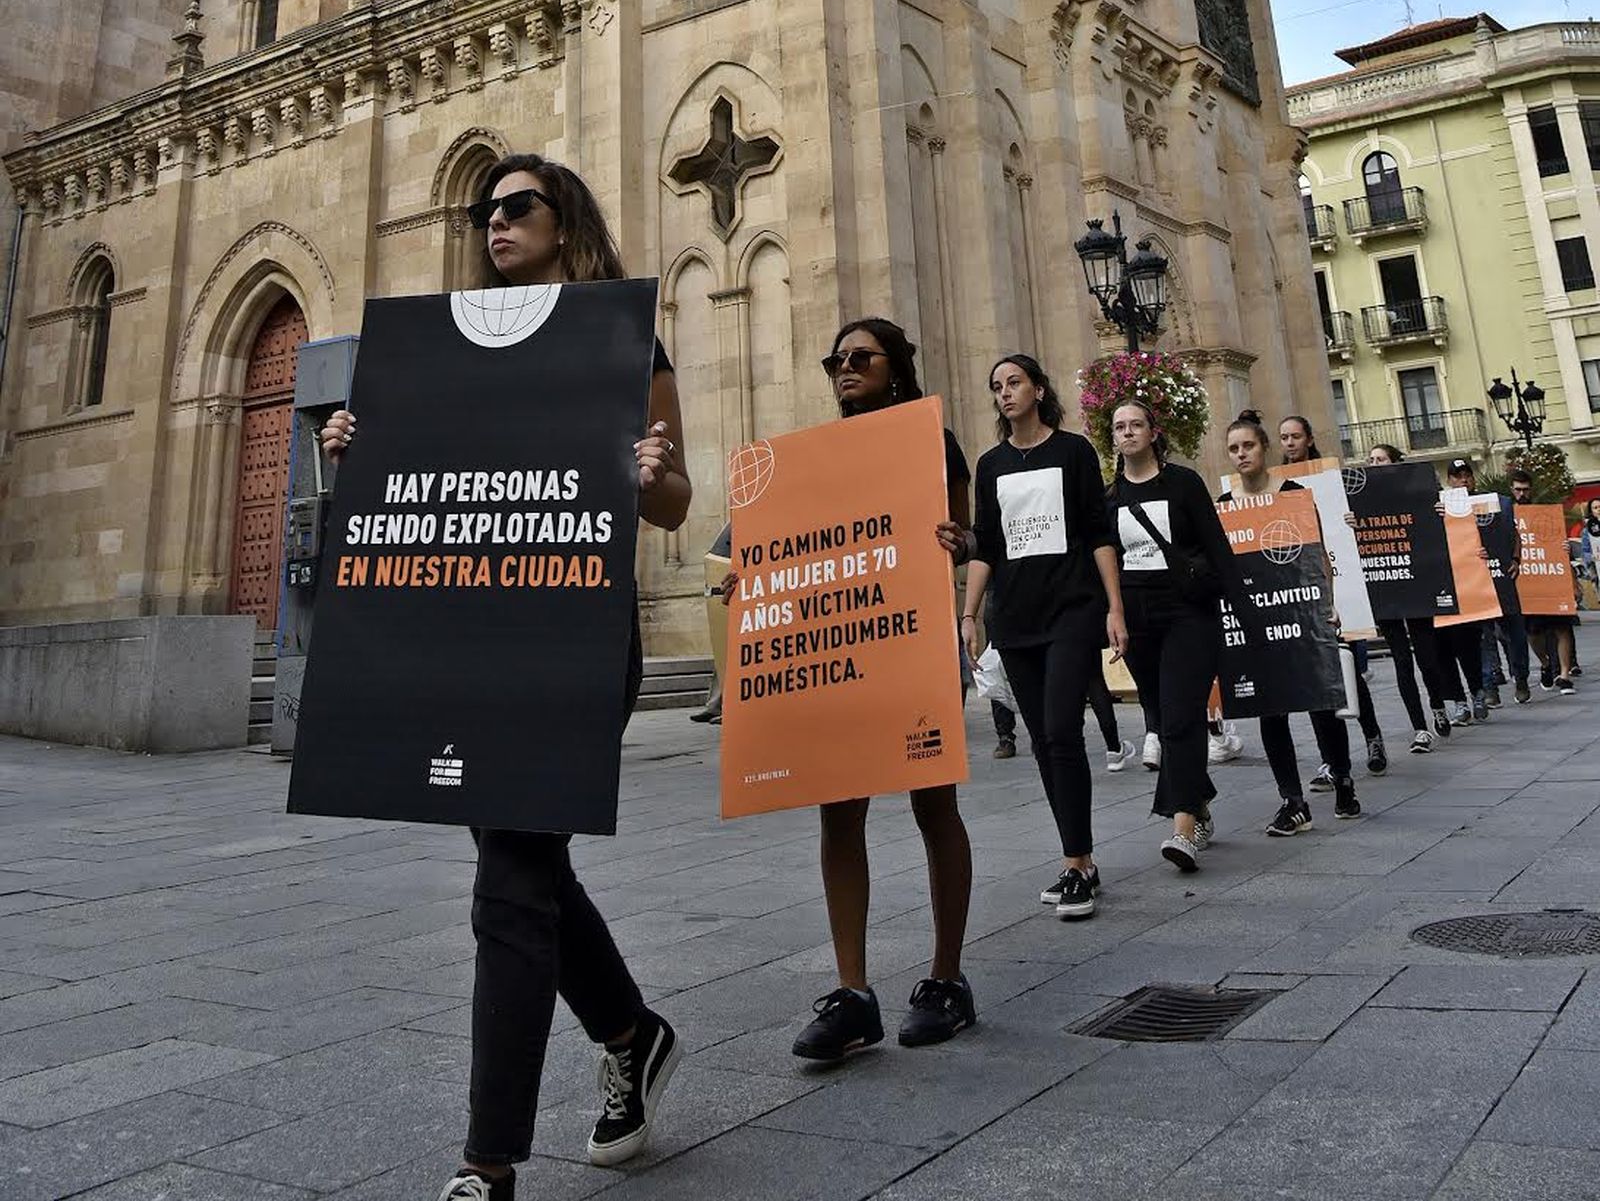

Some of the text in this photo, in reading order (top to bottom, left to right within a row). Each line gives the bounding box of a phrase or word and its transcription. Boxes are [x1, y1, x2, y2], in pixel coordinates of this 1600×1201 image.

[385, 469, 580, 503] HAY PERSONAS
[346, 511, 613, 545] SIENDO EXPLOTADAS
[1225, 528, 1254, 545] NDO
[1356, 528, 1407, 541] PERSONAS
[1368, 515, 1399, 527] TRATA
[1400, 514, 1413, 525] DE
[740, 514, 893, 568] YO CAMINO POR
[1358, 541, 1411, 555] OCURRE EN
[336, 555, 369, 586] EN
[374, 555, 491, 587] NUESTRA
[500, 555, 611, 587] CIUDAD.
[740, 545, 897, 601] LA MUJER DE 70
[1361, 555, 1411, 568] NUESTRAS
[1364, 569, 1414, 582] CIUDADES.
[740, 582, 885, 633] AÑOS VÍCTIMA
[1249, 586, 1320, 607] CLAVITUD
[740, 609, 918, 667] DE SERVIDUMBRE
[740, 657, 865, 701] DOMÉSTICA.
